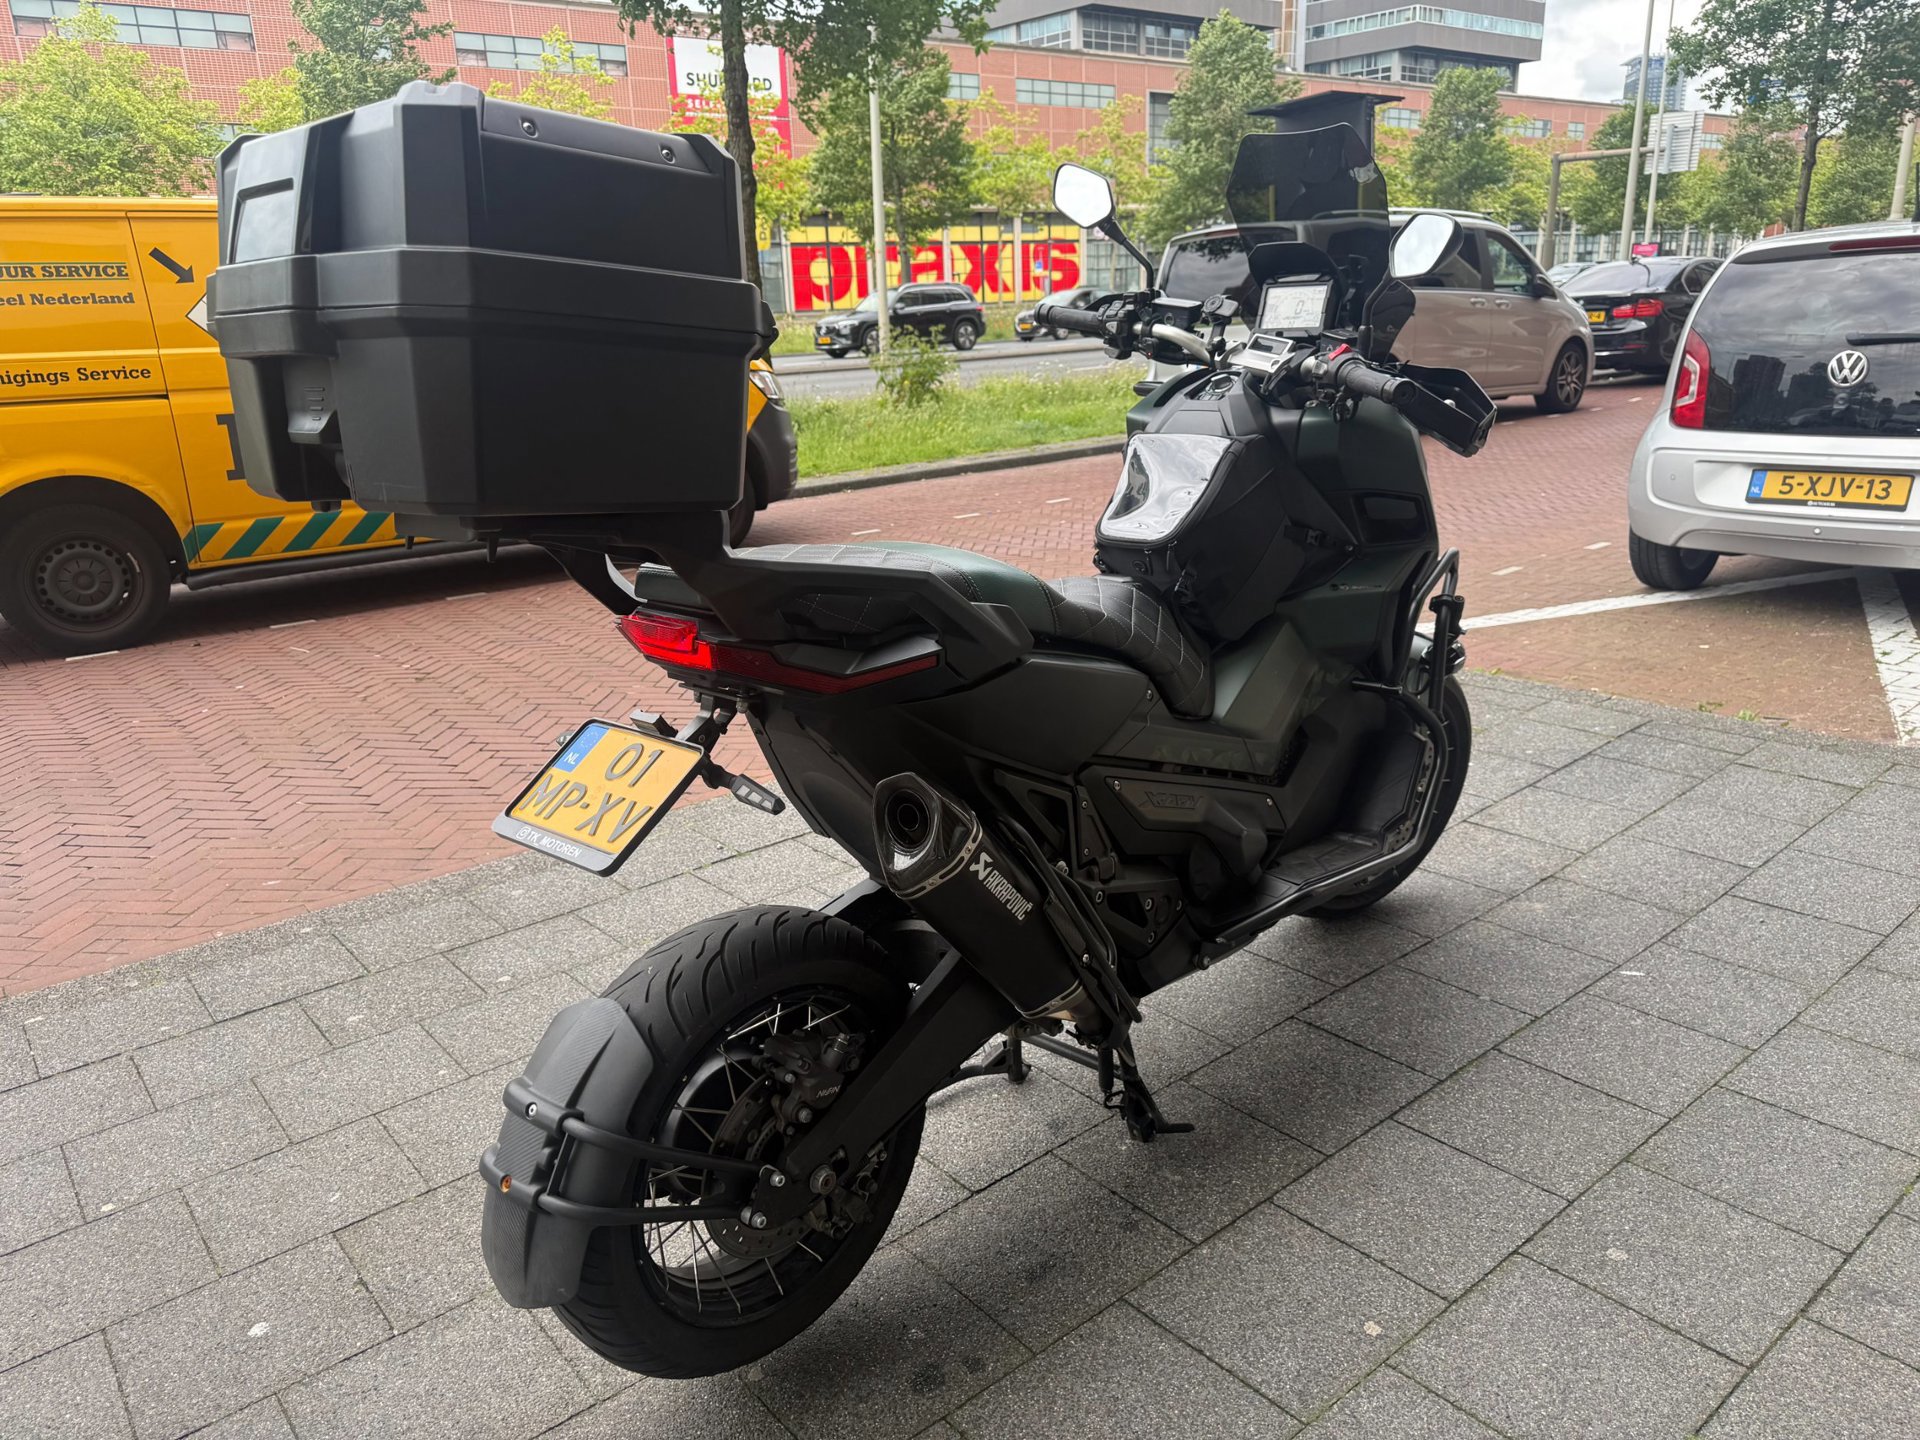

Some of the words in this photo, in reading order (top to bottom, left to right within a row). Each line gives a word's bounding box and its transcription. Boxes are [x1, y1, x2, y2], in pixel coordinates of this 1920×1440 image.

[42, 265, 129, 279] SERVICE
[790, 238, 1080, 311] praxis
[29, 292, 135, 306] Nederland
[77, 366, 152, 381] Service
[1750, 486, 1762, 494] NL
[1778, 474, 1893, 500] 5-XJV-13
[563, 752, 579, 765] NL
[604, 743, 665, 788] 01
[519, 774, 654, 843] MP-XV
